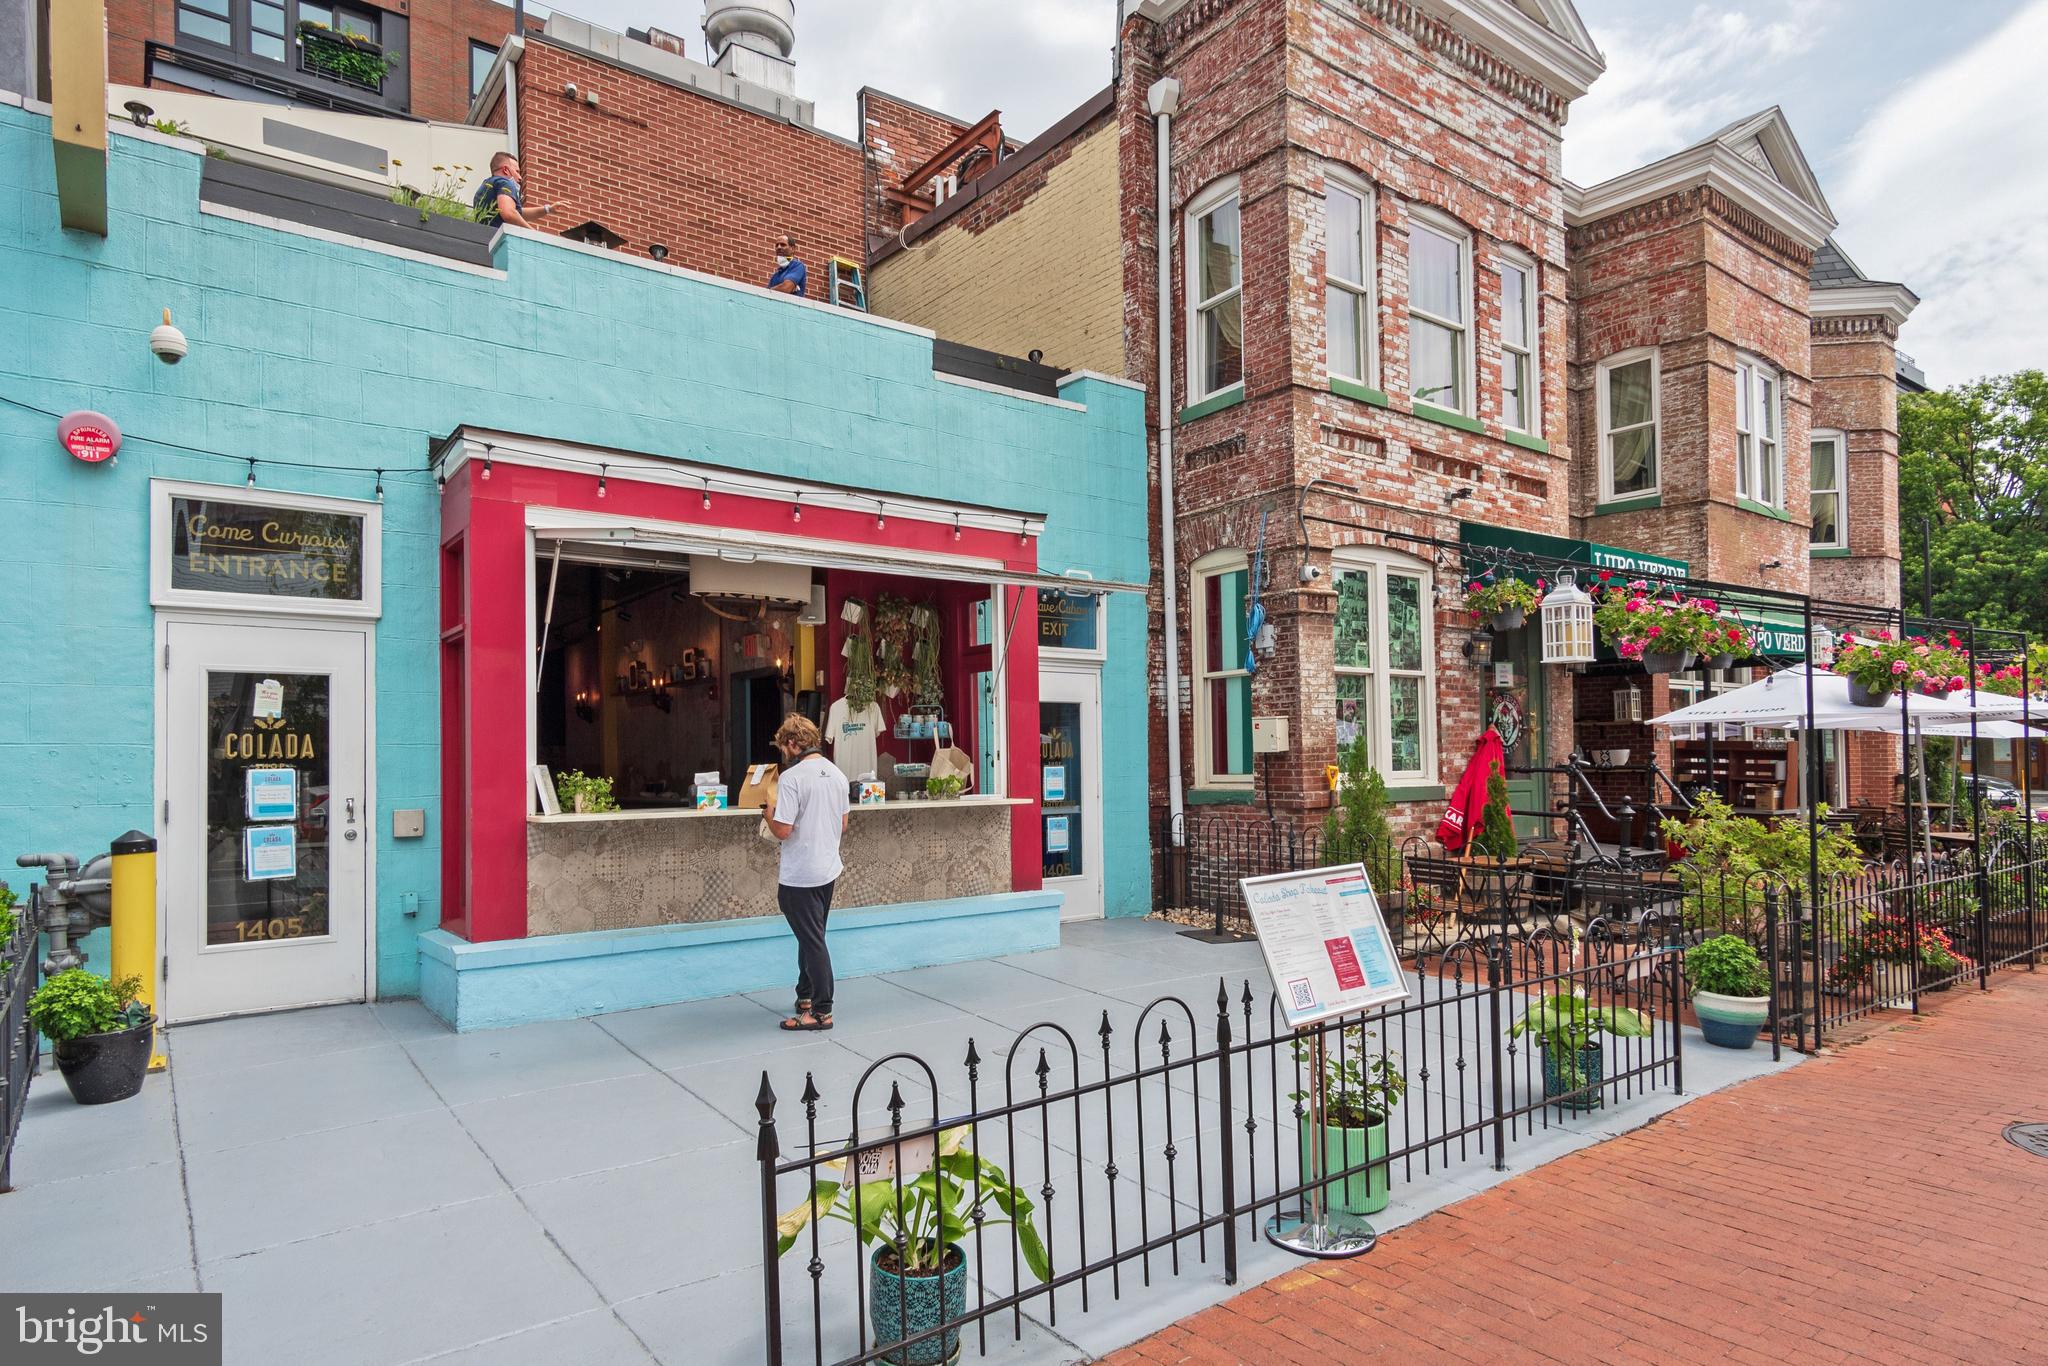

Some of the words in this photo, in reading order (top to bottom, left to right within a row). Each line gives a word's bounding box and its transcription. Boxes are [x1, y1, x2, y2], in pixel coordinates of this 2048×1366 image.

[72, 426, 107, 438] SPRINKLER
[81, 450, 100, 459] 911
[189, 515, 254, 541] Come
[262, 522, 349, 549] Curious
[189, 553, 348, 583] ENTRANCE
[1042, 622, 1069, 637] EXIT
[1774, 632, 1806, 653] VERD
[224, 732, 315, 759] COLADA
[1042, 863, 1072, 877] 1405
[235, 917, 303, 942] 1405
